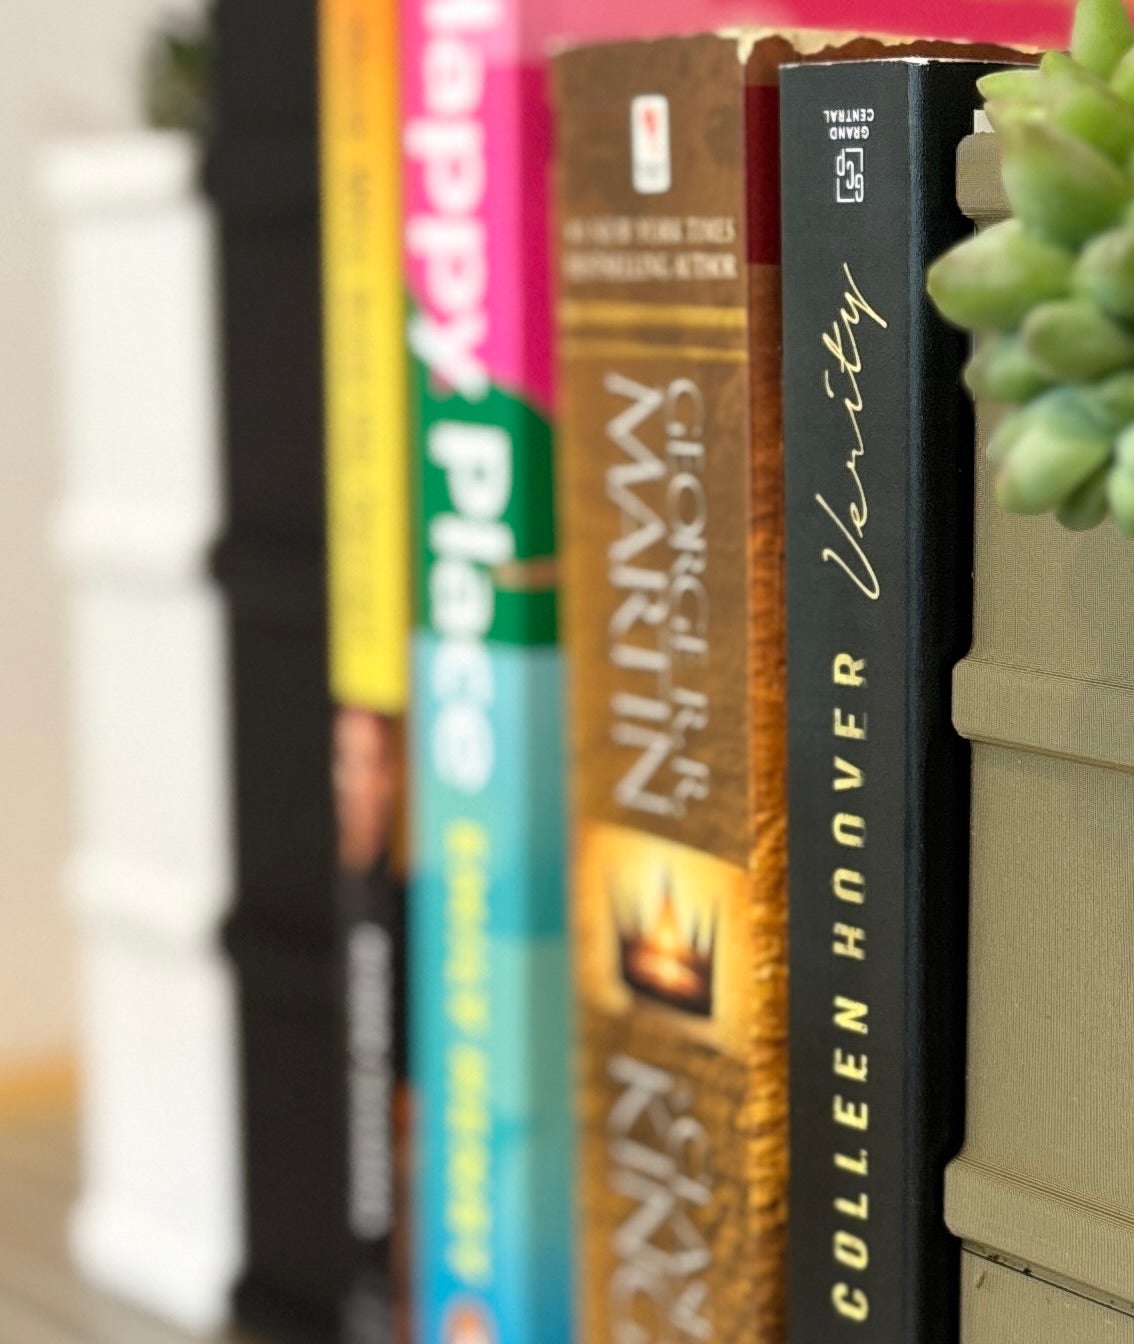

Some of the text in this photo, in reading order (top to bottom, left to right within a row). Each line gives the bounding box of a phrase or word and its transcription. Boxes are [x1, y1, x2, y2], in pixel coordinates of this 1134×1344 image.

[823, 108, 875, 124] CENTRAL
[829, 126, 870, 141] GRAND
[427, 419, 515, 795] Place
[602, 370, 674, 819] MARTIN
[814, 261, 888, 600] Verity
[831, 652, 870, 1324] COLLEEN HOOVER
